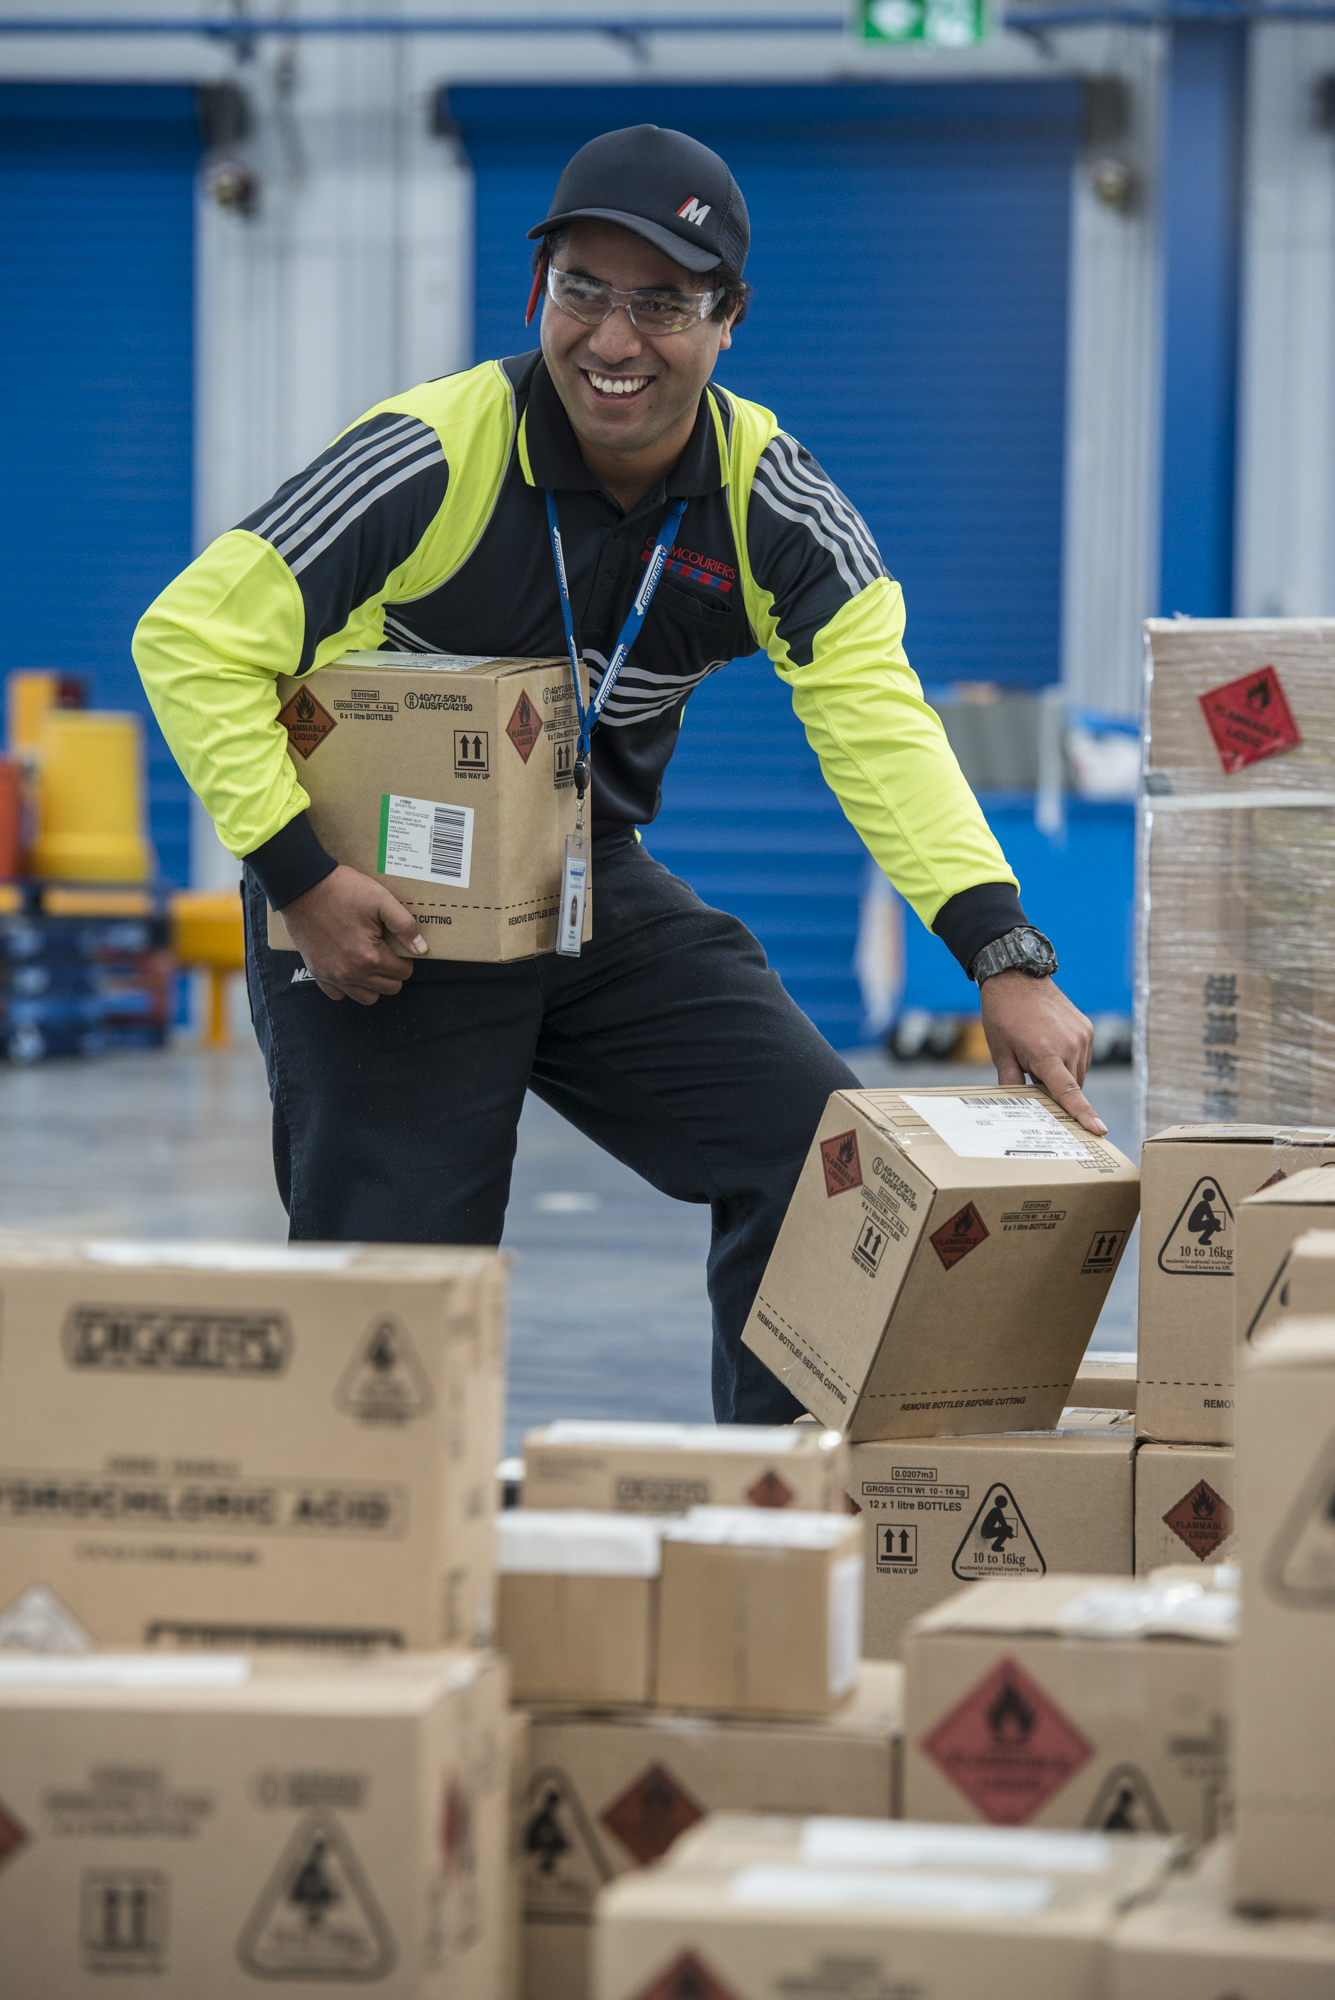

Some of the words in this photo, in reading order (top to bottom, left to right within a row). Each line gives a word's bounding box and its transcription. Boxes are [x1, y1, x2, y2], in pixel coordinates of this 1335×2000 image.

[676, 196, 711, 226] M
[646, 536, 737, 579] CMCOURIERS
[419, 694, 466, 702] 4G/Y7.5/S/15
[419, 702, 472, 711] AUS/FC/42190
[419, 915, 452, 925] CUTTING
[508, 914, 527, 926] REMOVE
[528, 909, 547, 921] BOTTLES
[824, 1152, 854, 1184] FLAMMABLE
[828, 1167, 845, 1186] LIQUID
[881, 1173, 917, 1211] AUS/FC/42190
[872, 1210, 880, 1222] litre
[880, 1219, 900, 1241] BOTTLES
[1180, 1246, 1191, 1256] 10
[1194, 1247, 1205, 1257] to
[1209, 1246, 1233, 1260] 16kg
[852, 1252, 860, 1265] THIS
[860, 1262, 870, 1274] WAY
[757, 1311, 779, 1337] REMOVE
[778, 1333, 803, 1360] BOTTLES
[802, 1356, 824, 1382] BEFORE
[824, 1378, 847, 1405] CUTTING
[900, 1402, 931, 1411] REMOVE
[932, 1401, 965, 1409] BOTTLES
[965, 1399, 993, 1407] BEFORE
[995, 1397, 1026, 1405] CUTTING
[895, 1470, 933, 1478] 0.0207m3
[956, 1489, 965, 1497] kg
[869, 1500, 879, 1508] 12
[890, 1501, 894, 1509] 1
[898, 1501, 915, 1510] litre
[918, 1502, 961, 1511] BOTTLES
[1189, 1531, 1218, 1539] LIQUID
[973, 1552, 984, 1563] 10
[987, 1554, 998, 1563] to
[1002, 1553, 1026, 1567] 16kg
